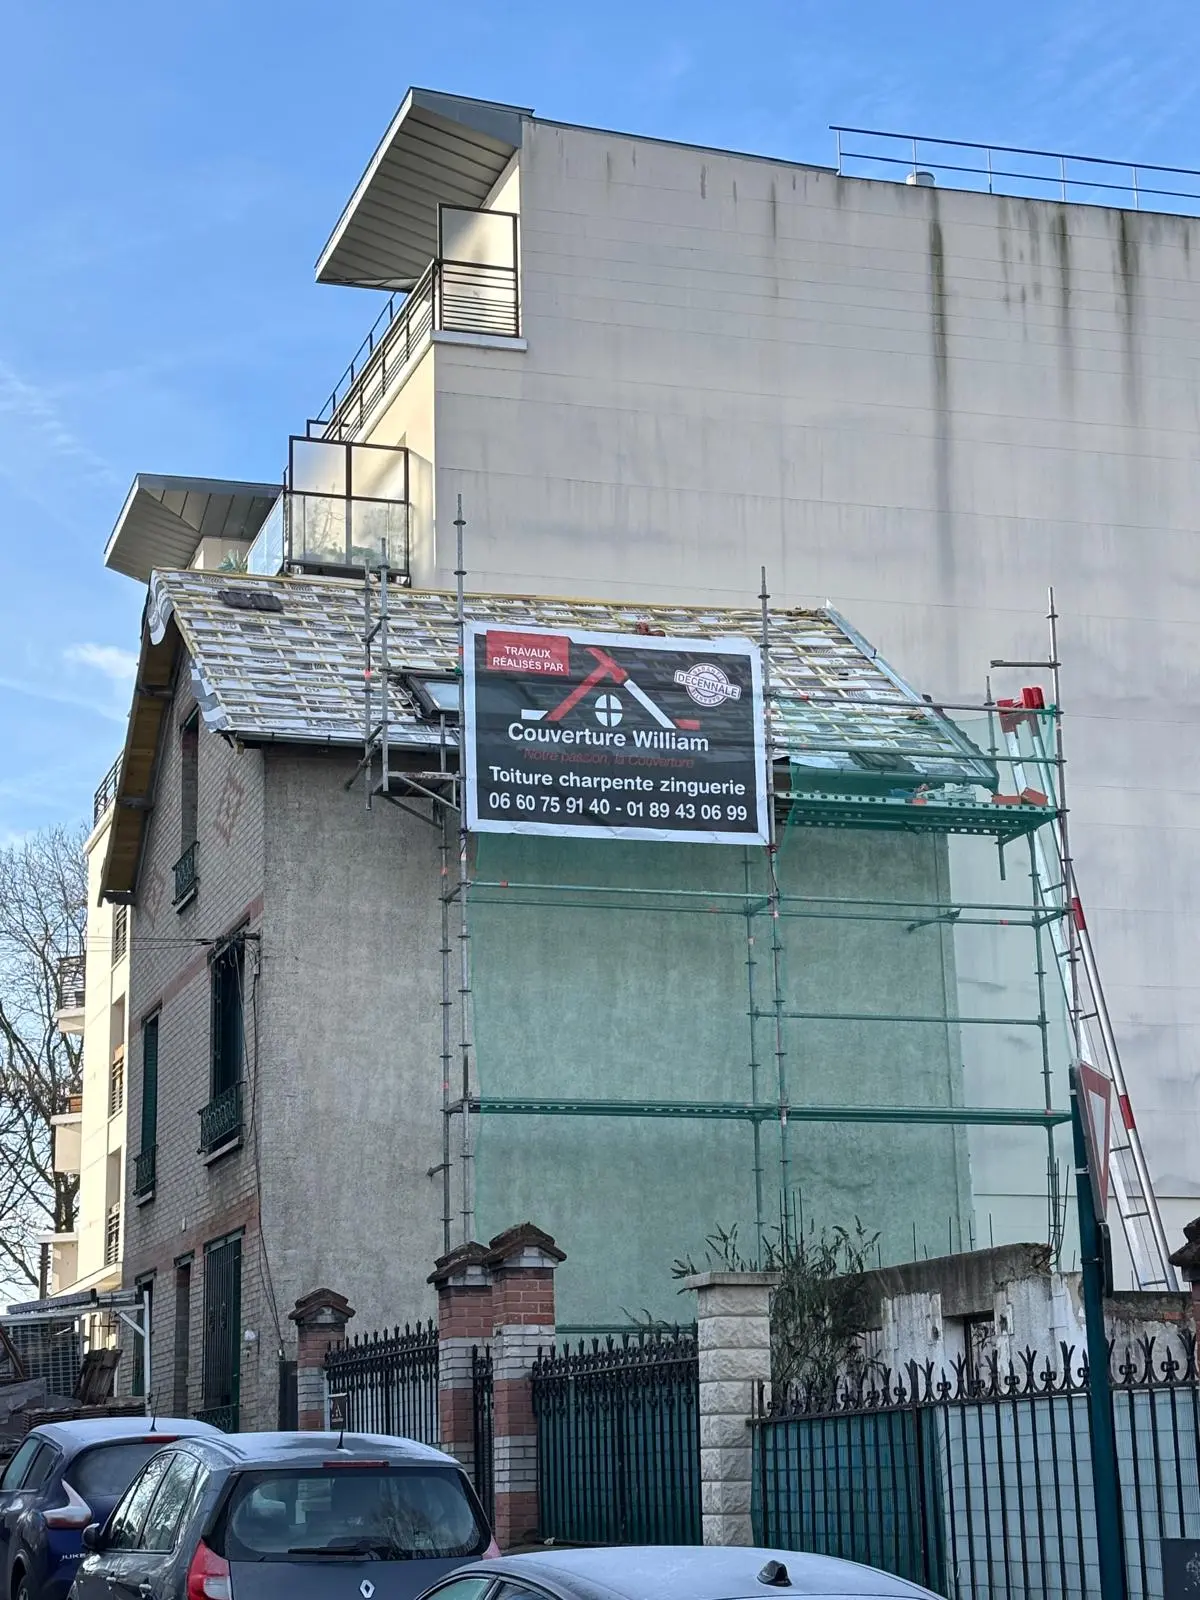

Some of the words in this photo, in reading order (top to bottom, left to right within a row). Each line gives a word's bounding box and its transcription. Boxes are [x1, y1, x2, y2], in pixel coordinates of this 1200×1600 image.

[492, 656, 541, 670] RÉALISÉS
[544, 662, 564, 672] PAR
[504, 645, 551, 659] TRAVAUX
[677, 673, 738, 698] DECENNALE
[508, 722, 626, 747] Couverture
[632, 730, 709, 751] William
[489, 766, 553, 786] Toiture
[558, 772, 654, 792] charpente
[659, 777, 746, 797] zinguerie
[489, 792, 511, 809] 06
[515, 795, 536, 811] 60
[540, 796, 560, 813] 75
[565, 797, 584, 814] 91
[588, 798, 610, 815] 40
[626, 801, 644, 817] 01
[649, 802, 670, 818] 89
[674, 803, 696, 819] 43
[700, 804, 722, 821] 06
[726, 805, 747, 821] 99
